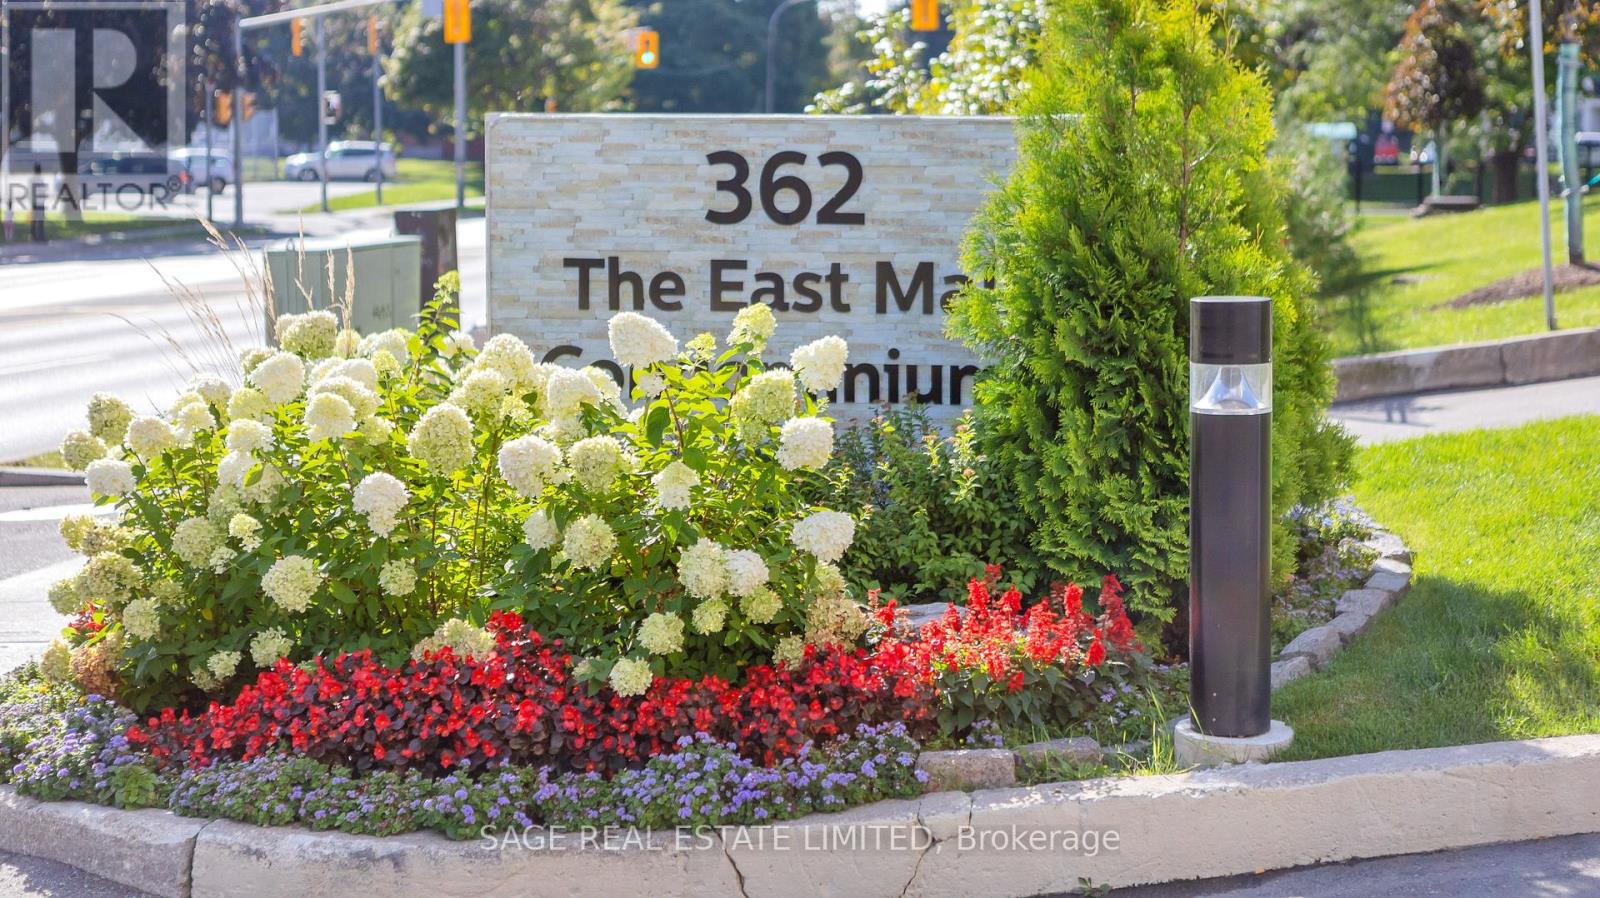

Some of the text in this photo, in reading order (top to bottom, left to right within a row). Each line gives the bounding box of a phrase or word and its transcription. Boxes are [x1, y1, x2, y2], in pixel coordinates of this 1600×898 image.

[705, 150, 865, 225] 362
[563, 256, 685, 310] The
[710, 259, 851, 313] East
